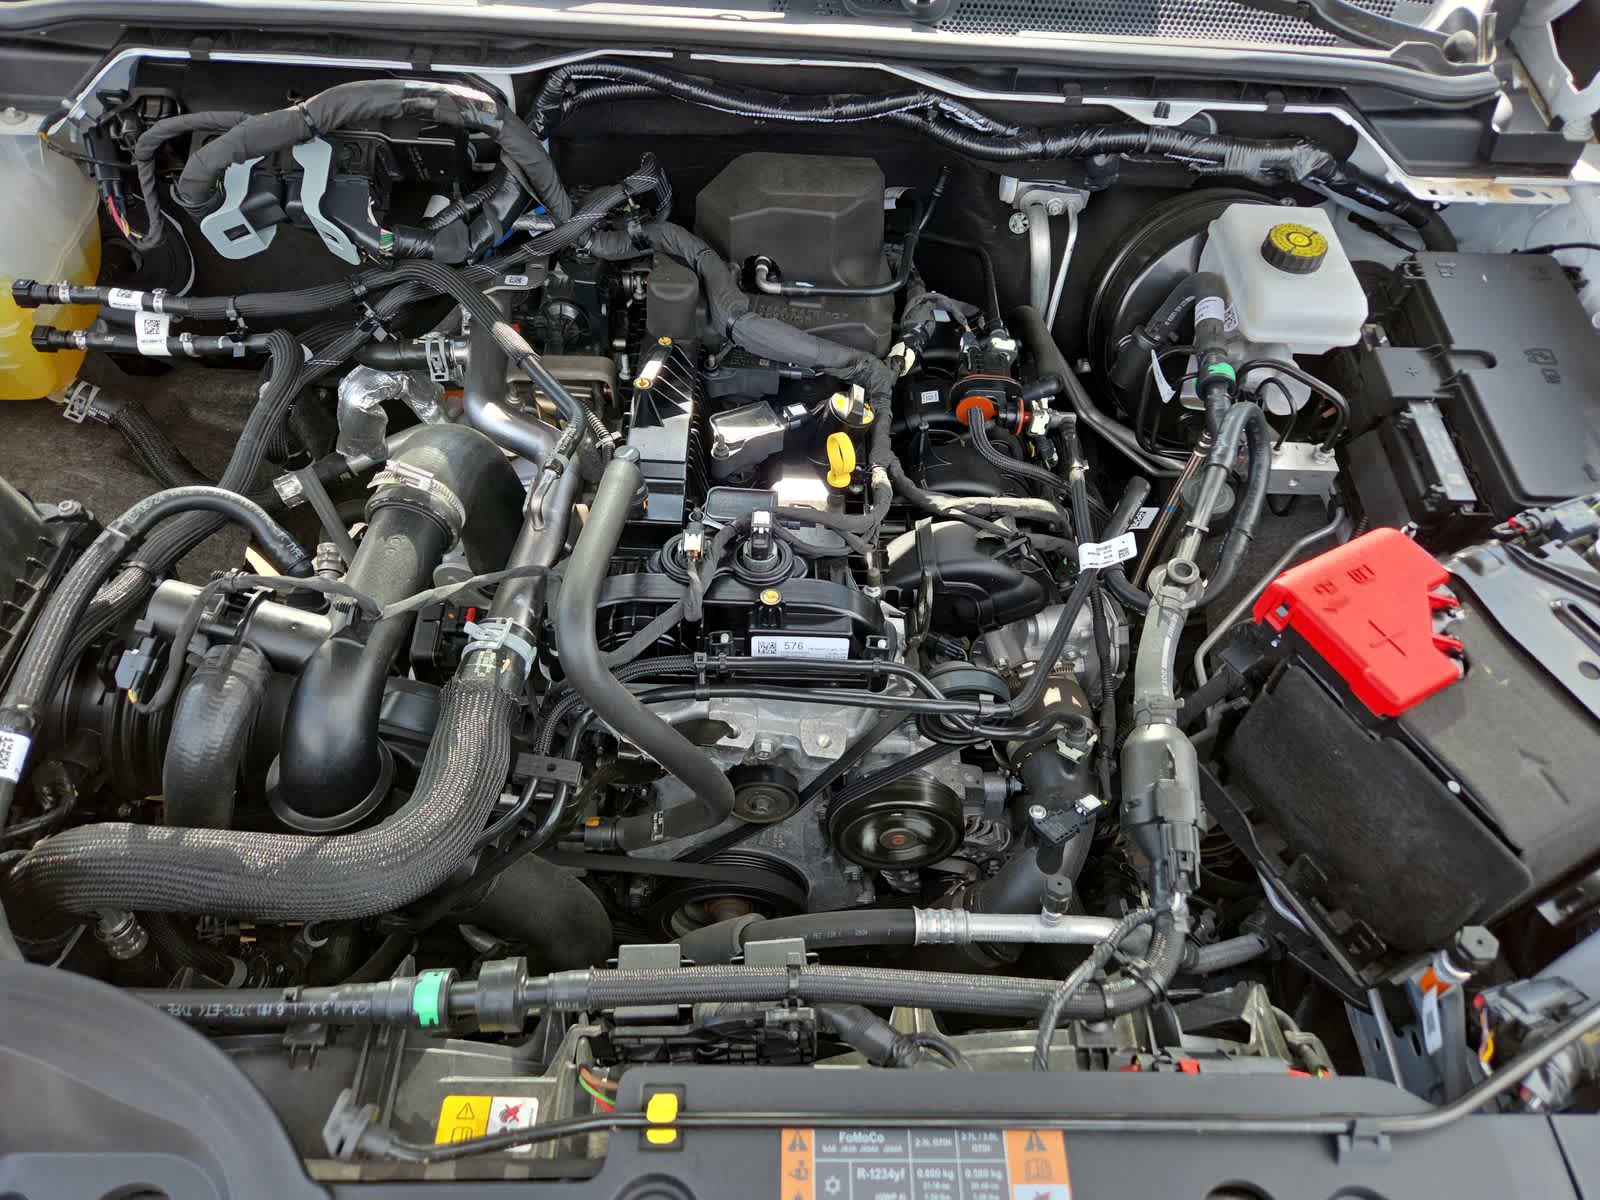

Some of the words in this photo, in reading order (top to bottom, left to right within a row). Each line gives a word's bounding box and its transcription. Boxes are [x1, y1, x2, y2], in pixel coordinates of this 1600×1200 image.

[783, 641, 804, 650] 576
[838, 1130, 885, 1144] FoMoCo
[856, 1167, 905, 1183] R-1234yf
